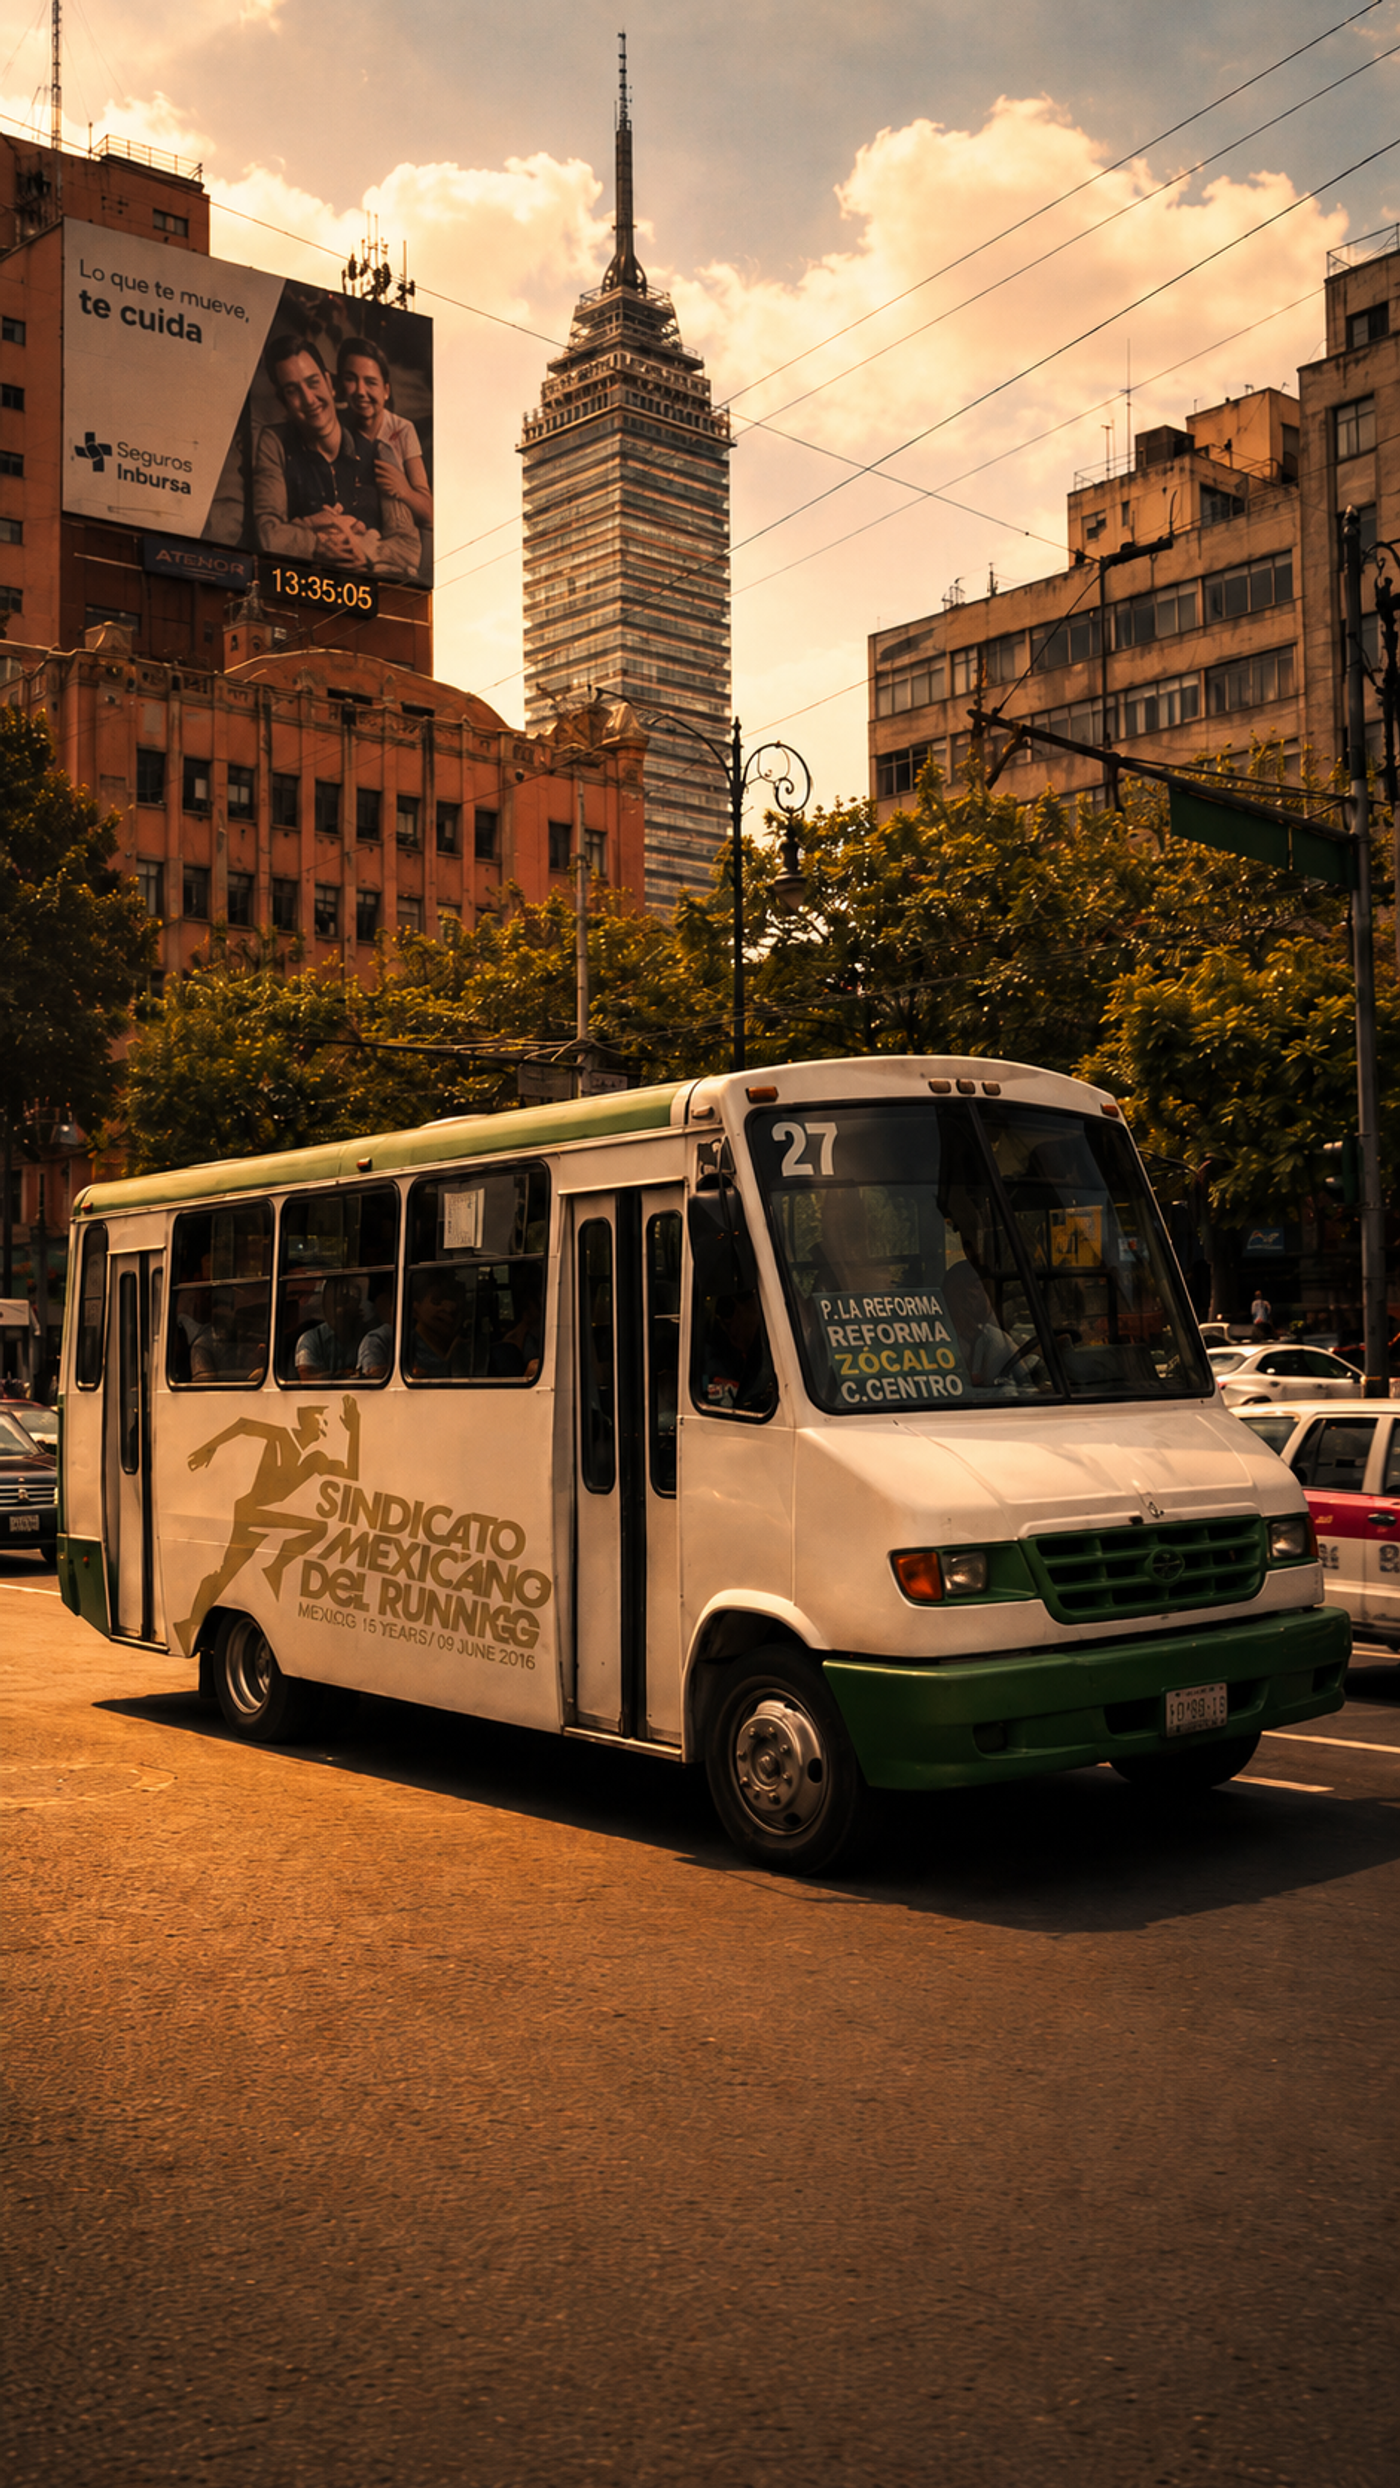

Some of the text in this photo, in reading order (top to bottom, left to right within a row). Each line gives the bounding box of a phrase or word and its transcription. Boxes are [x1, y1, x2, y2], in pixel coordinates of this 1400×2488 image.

[79, 258, 250, 323] Lo que te mueve,
[79, 289, 203, 344] te cuida
[117, 441, 193, 474] Seguros
[117, 462, 192, 495] Inbursa
[155, 549, 246, 576] ATENOR
[271, 568, 373, 610] 13:35:05
[771, 1121, 838, 1177] 27
[862, 1296, 944, 1318] REFORMA
[827, 1321, 952, 1348] REFORMA
[834, 1346, 957, 1375] ZÓCALO
[315, 1480, 527, 1560] SINDICATO
[316, 1527, 552, 1609] MEXICANO
[363, 1617, 378, 1634] 15
[437, 1634, 455, 1652] 09
[457, 1638, 496, 1662] JUNE
[498, 1649, 536, 1671] 2016
